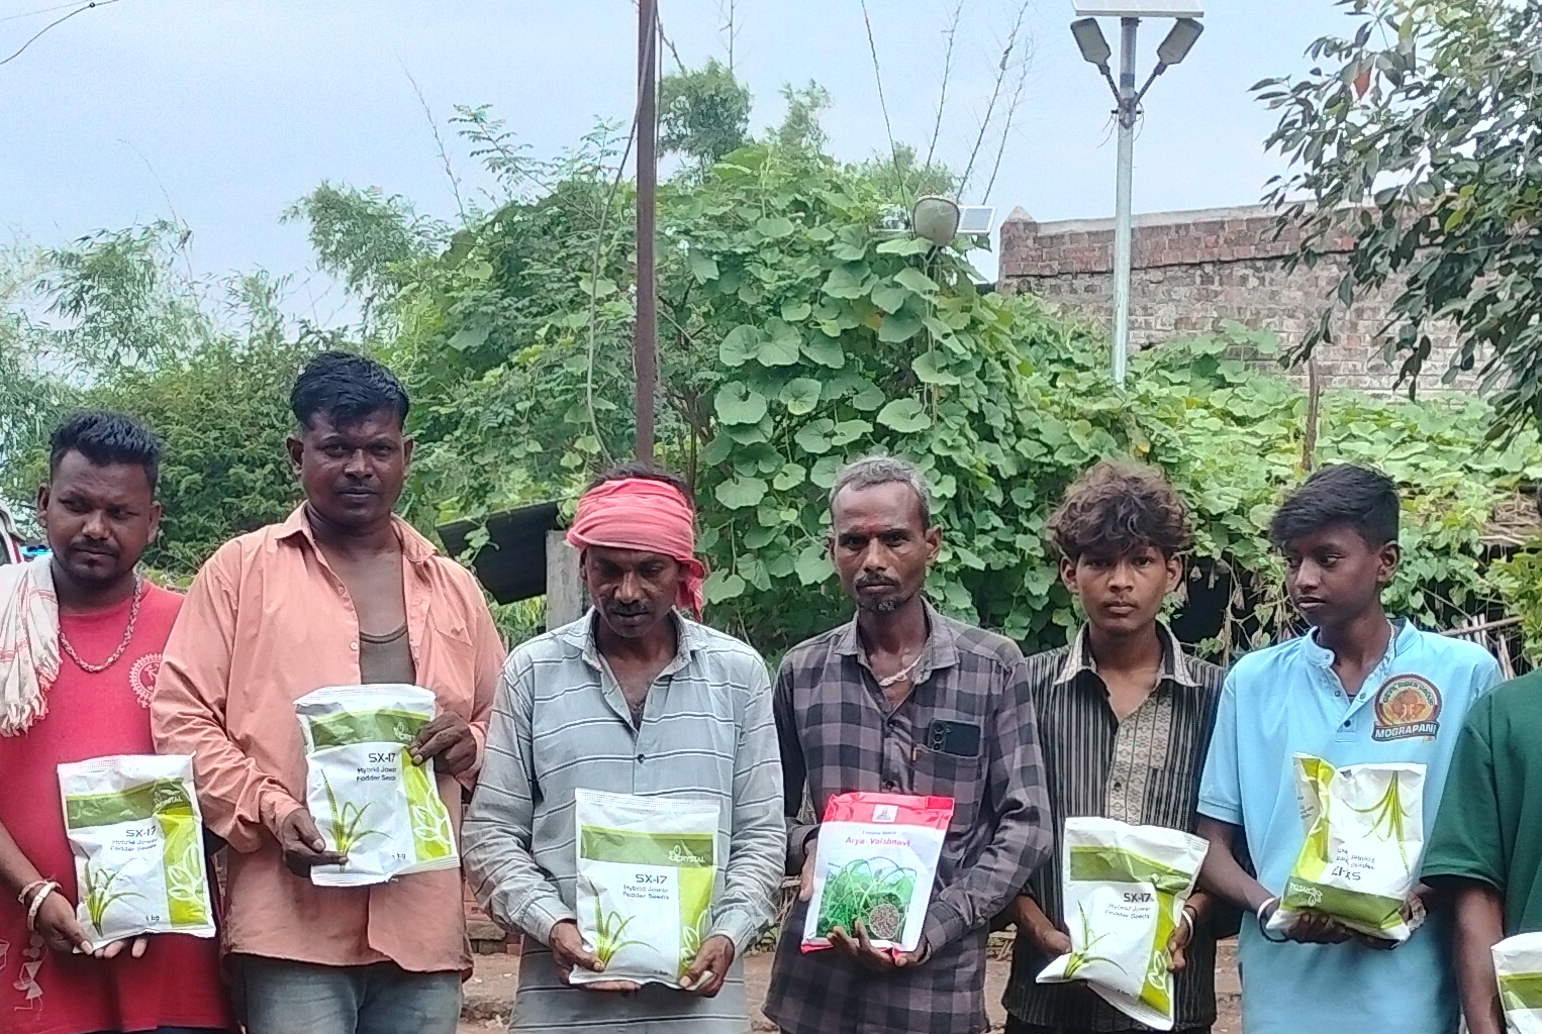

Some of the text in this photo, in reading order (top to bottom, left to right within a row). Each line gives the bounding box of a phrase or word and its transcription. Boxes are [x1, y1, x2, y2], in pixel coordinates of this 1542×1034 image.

[1375, 724, 1437, 738] MOGRAPANI
[369, 752, 395, 762] SX-17
[126, 825, 156, 837] SX-17
[635, 874, 667, 884] SX-17
[1124, 893, 1151, 902] SX-17
